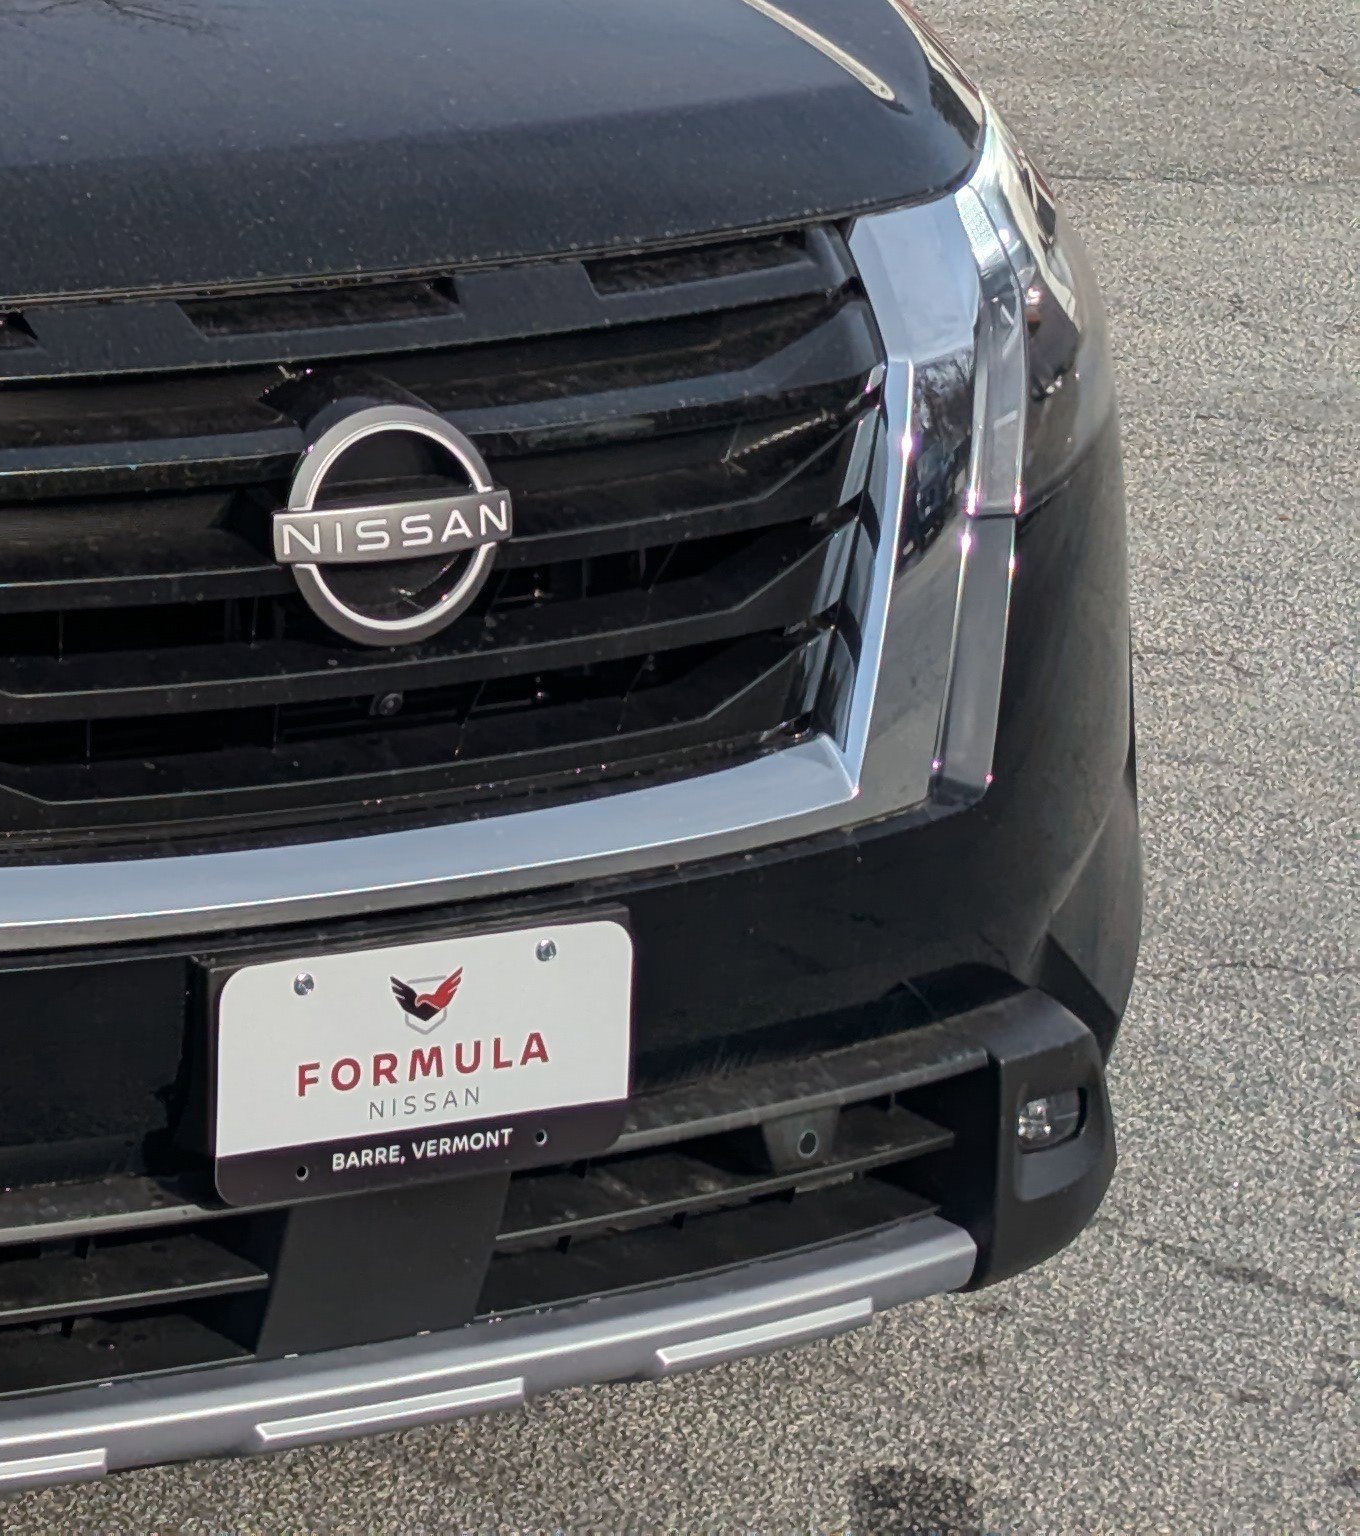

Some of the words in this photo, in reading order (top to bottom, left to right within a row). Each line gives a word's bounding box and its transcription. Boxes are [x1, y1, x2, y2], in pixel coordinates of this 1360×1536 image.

[283, 500, 507, 556] NISSAN
[297, 1032, 550, 1098] FORMULA
[369, 1086, 481, 1120] NISSAN
[332, 1145, 406, 1171] BARRE,
[412, 1127, 514, 1160] VERMONT
